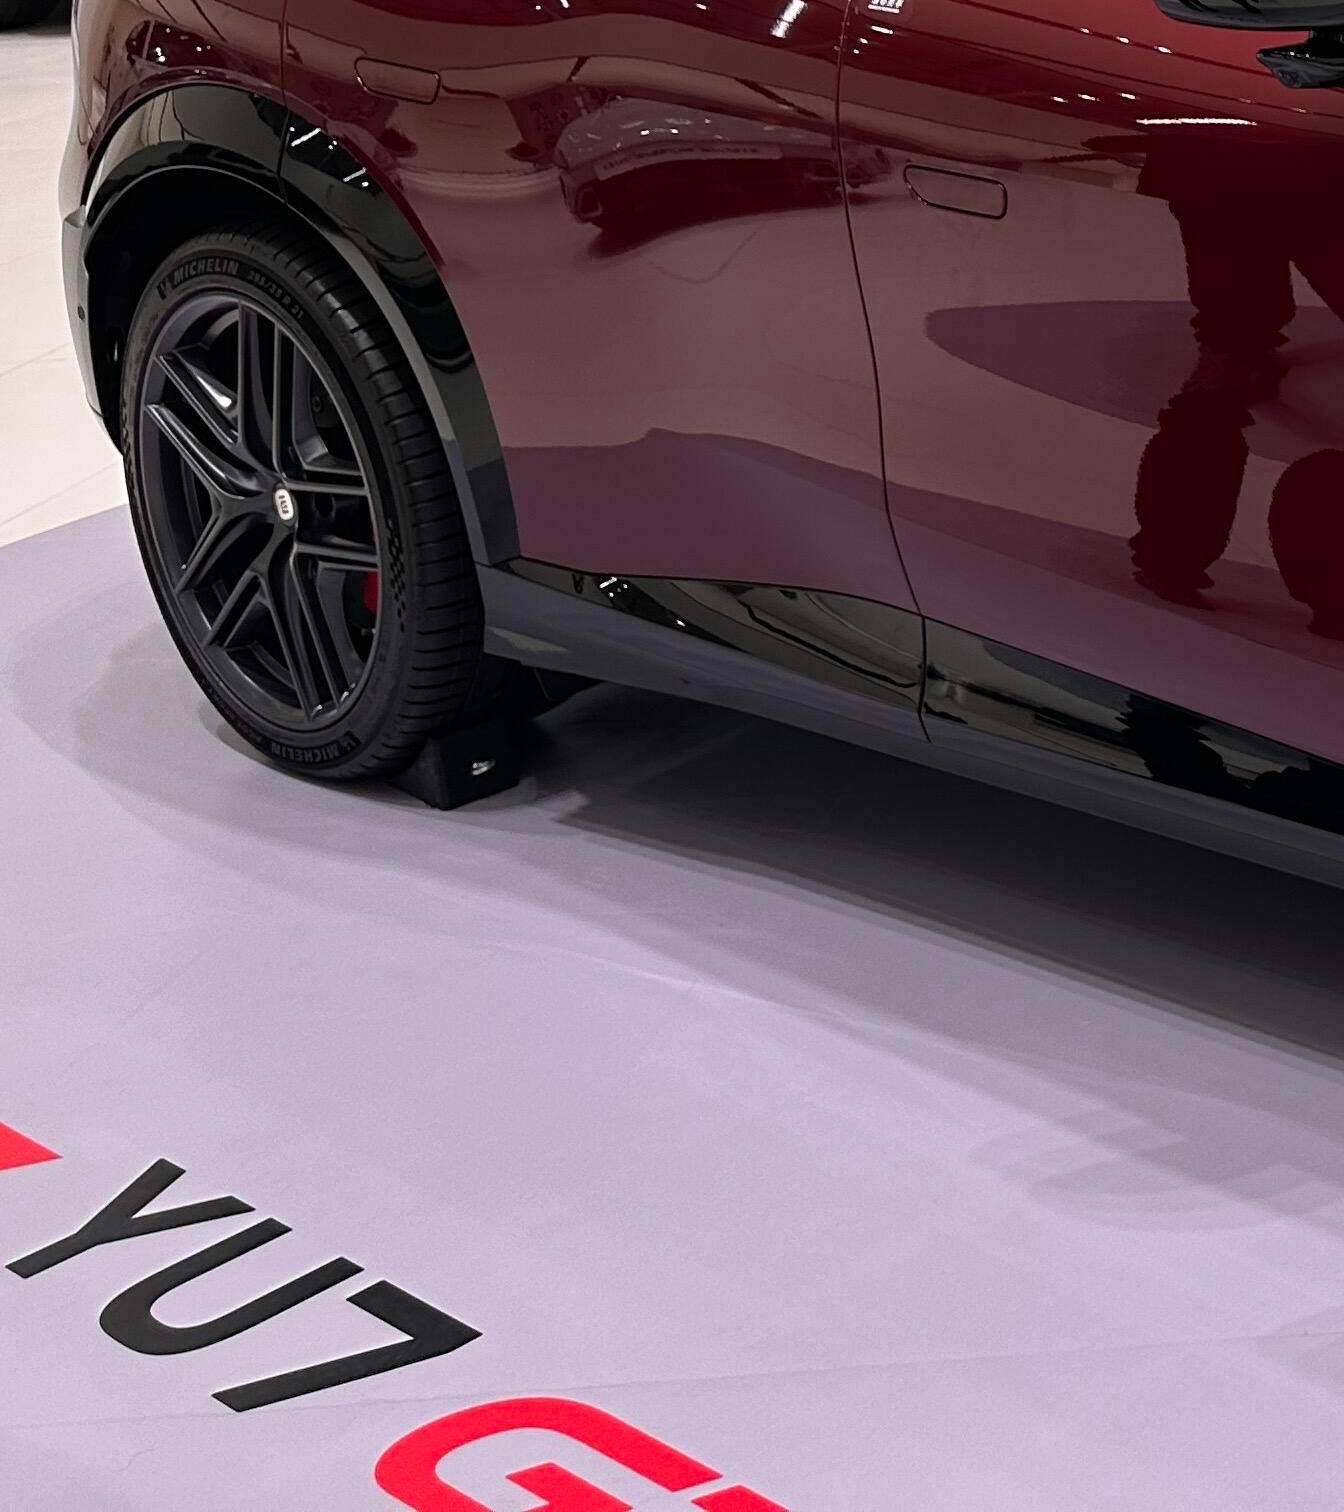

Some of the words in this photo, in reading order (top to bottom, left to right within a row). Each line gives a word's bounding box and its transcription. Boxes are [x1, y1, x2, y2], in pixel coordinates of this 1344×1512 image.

[173, 257, 240, 286] MICHELIN
[4, 1156, 484, 1413] YU7
[373, 1395, 791, 1512] G
